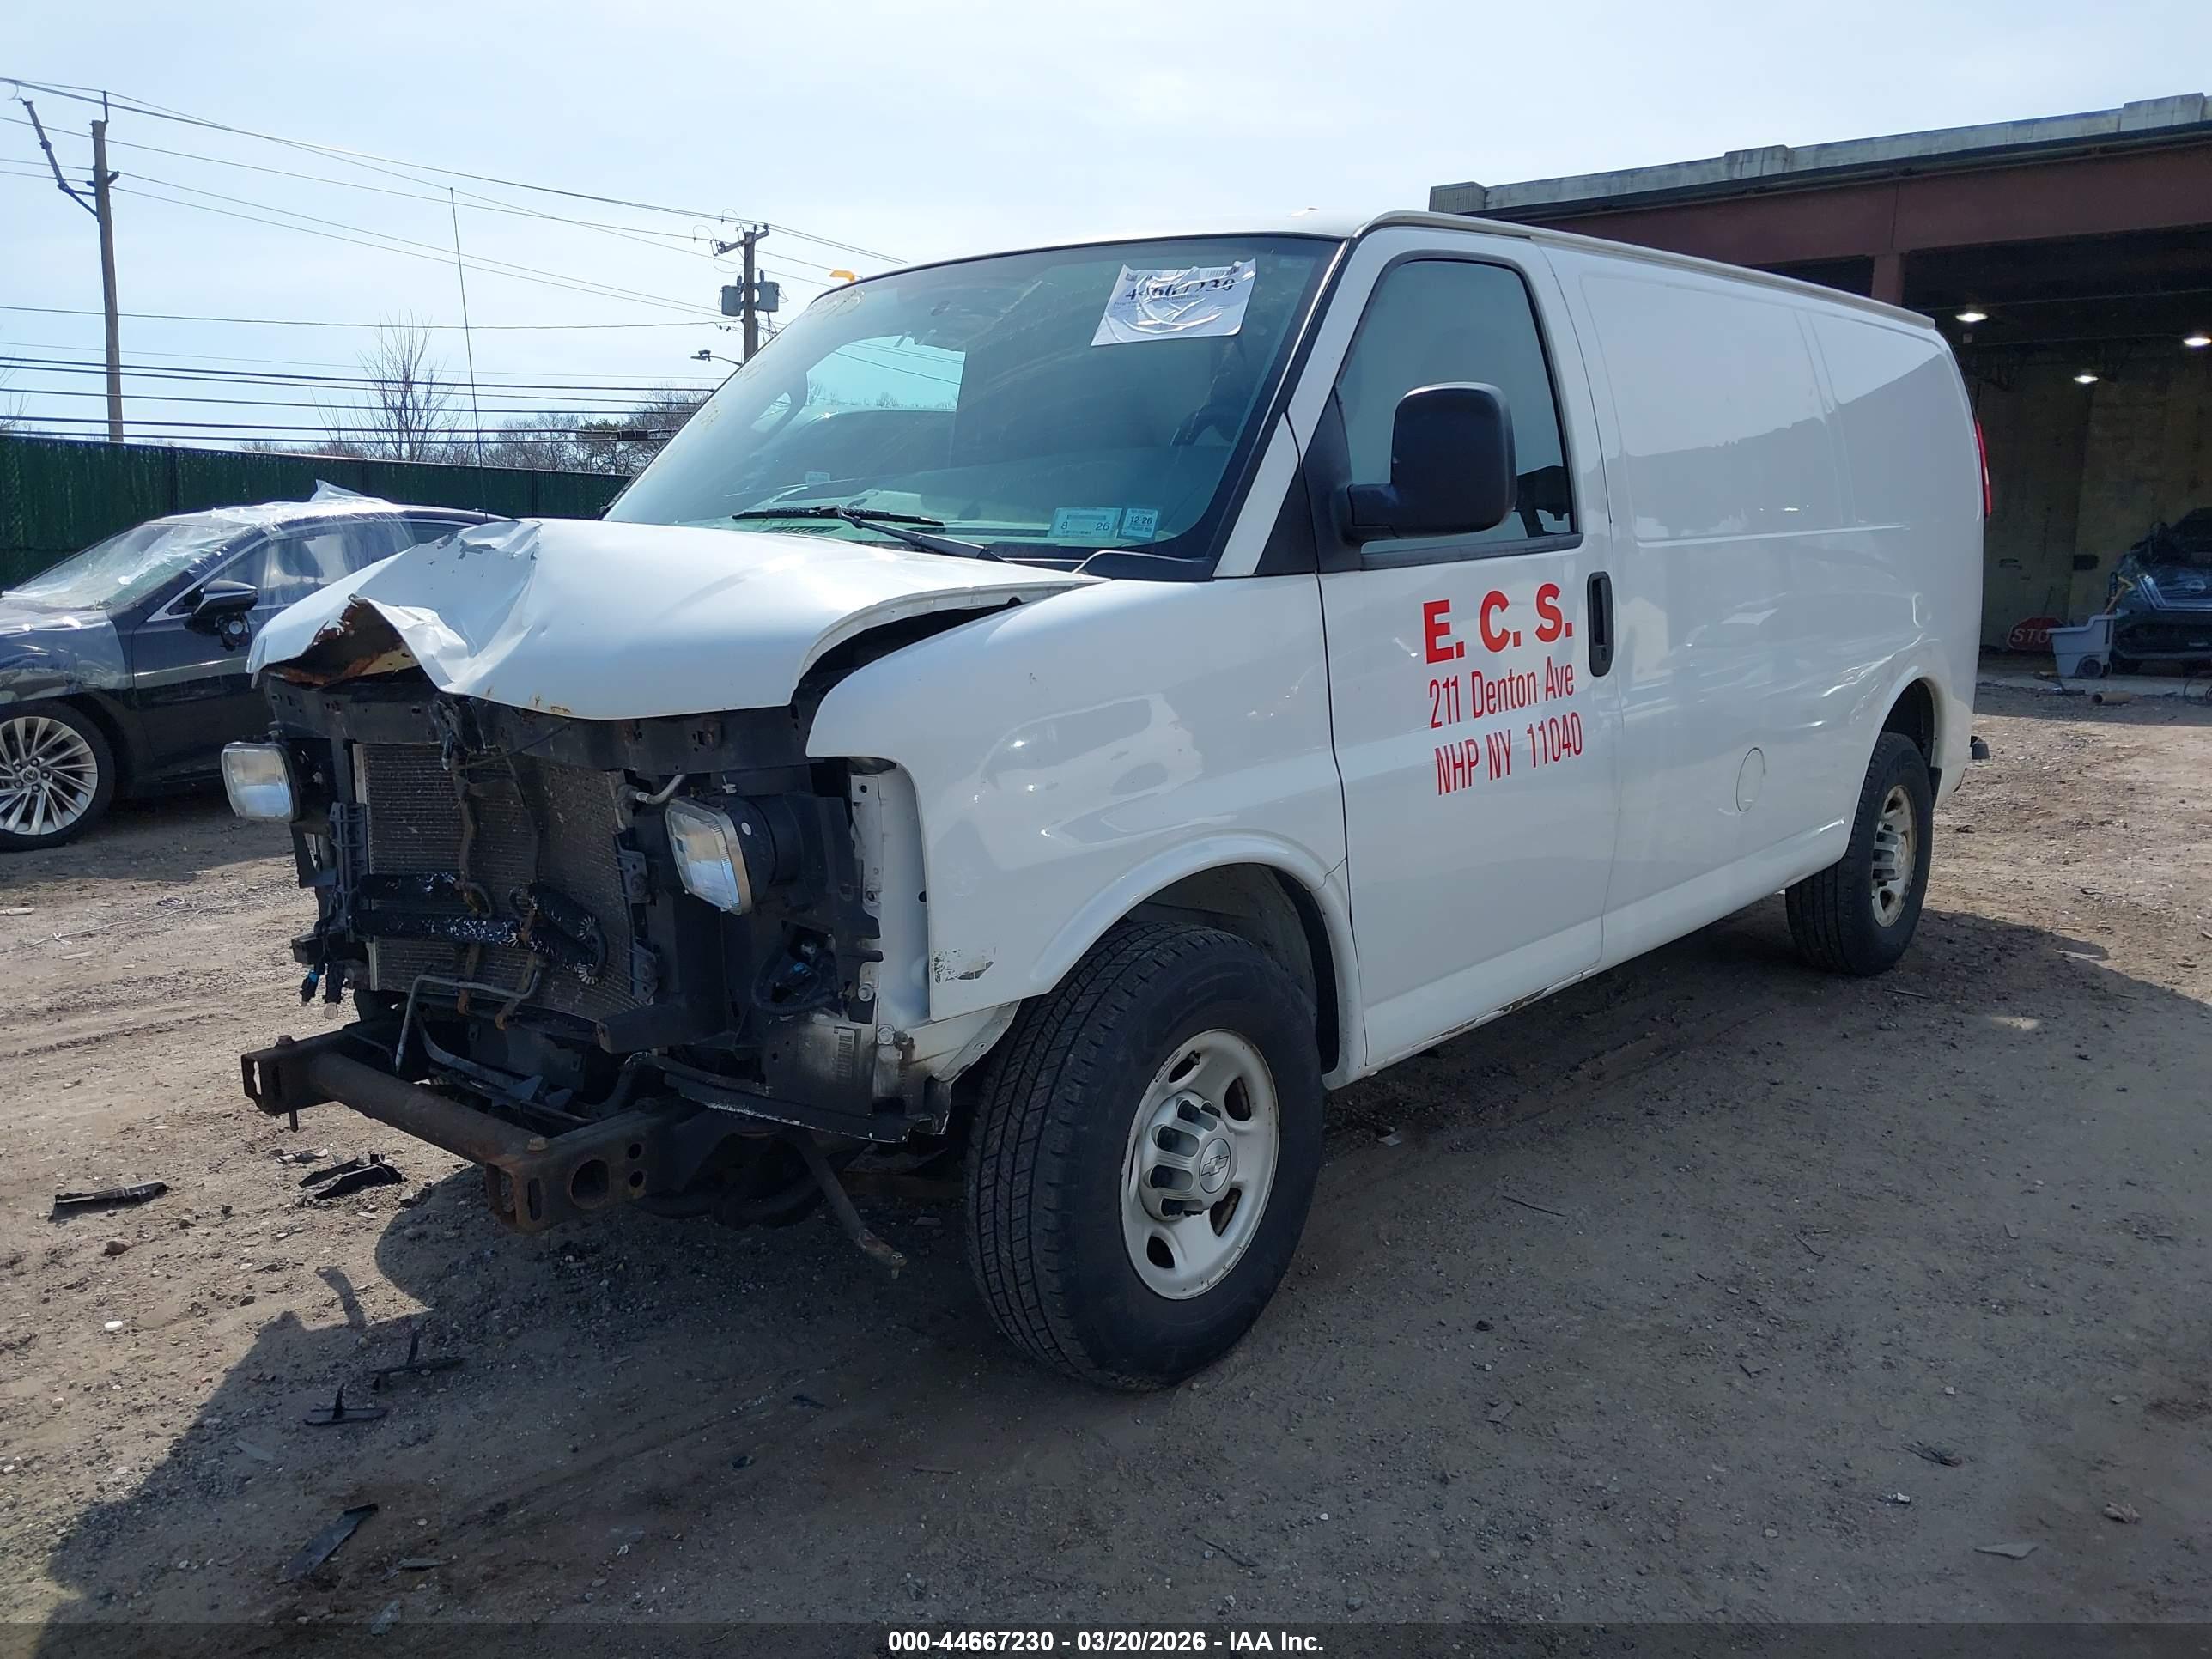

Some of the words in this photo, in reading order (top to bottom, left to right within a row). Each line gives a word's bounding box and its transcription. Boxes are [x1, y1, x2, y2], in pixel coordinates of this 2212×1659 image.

[1060, 521, 1068, 530] 8
[1095, 522, 1110, 531] 26
[1423, 599, 1465, 665] E.
[1480, 590, 1522, 653] C.
[1535, 582, 1573, 642] S.
[2012, 628, 2049, 643] STO
[1429, 675, 1462, 729] 211
[1471, 669, 1538, 719] Denton
[1545, 656, 1574, 702] Ave
[1435, 738, 1480, 796] NHP
[1486, 729, 1511, 781] NY
[1527, 711, 1583, 768] 11040
